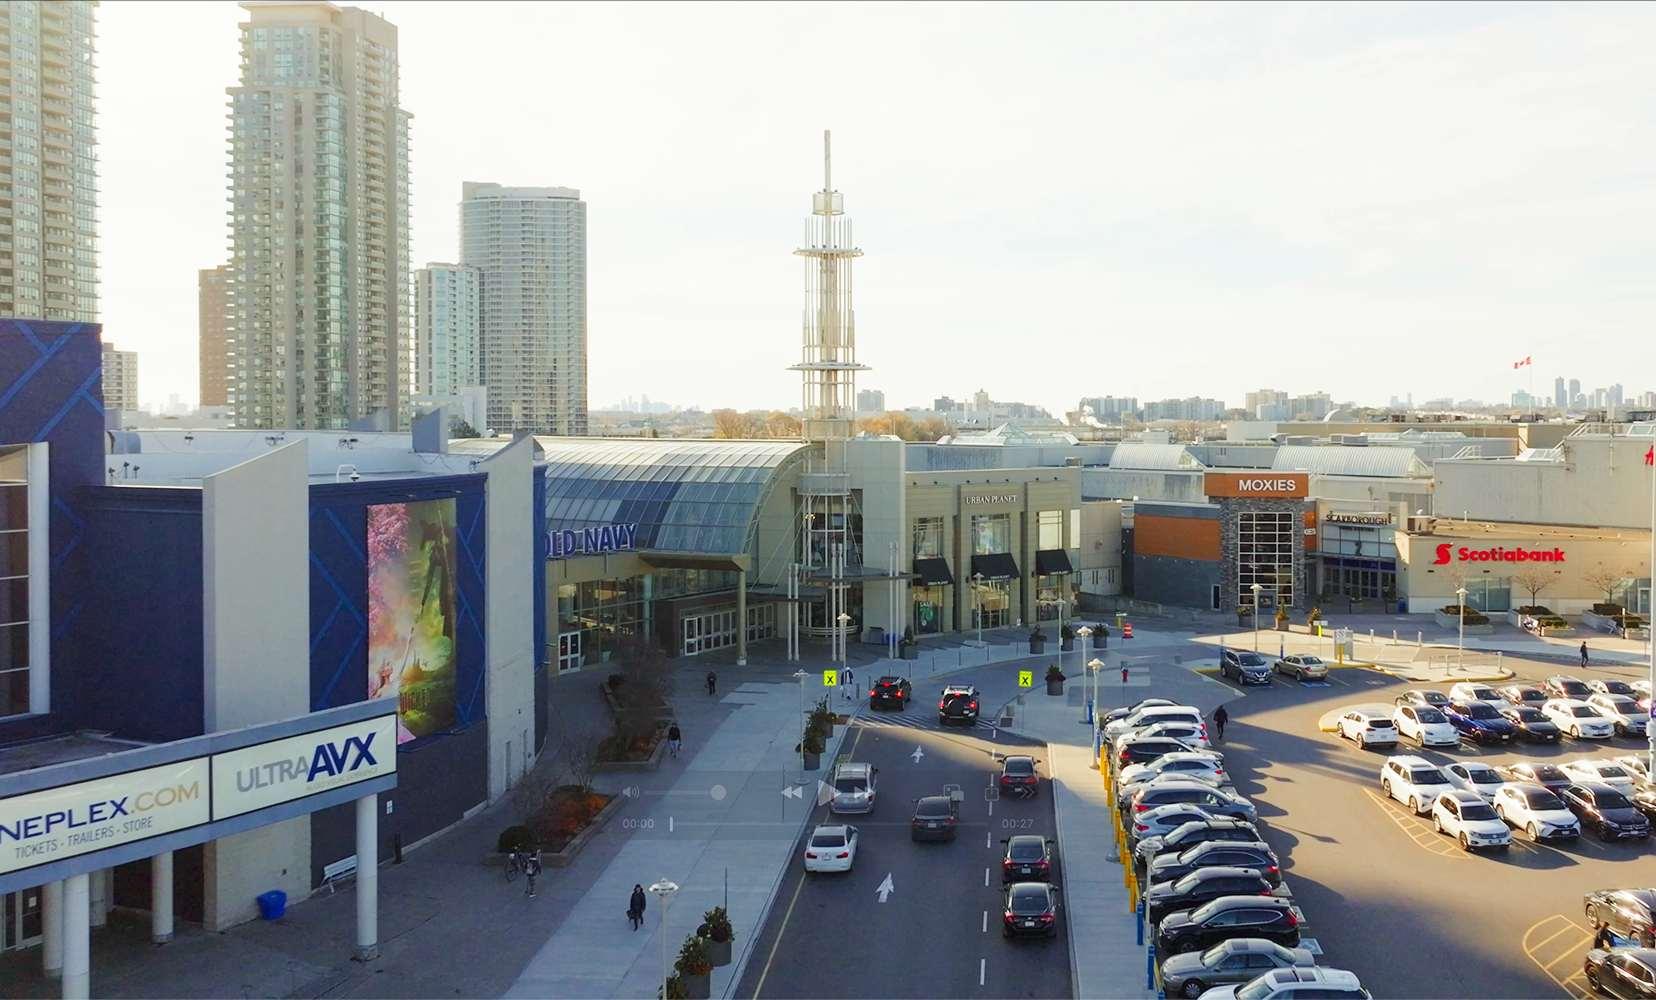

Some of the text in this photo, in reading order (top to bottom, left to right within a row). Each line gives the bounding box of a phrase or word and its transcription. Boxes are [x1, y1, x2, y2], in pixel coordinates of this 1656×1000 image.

[1238, 479, 1296, 492] MOXIES
[966, 495, 1017, 504] URBAN PLANET
[583, 523, 638, 554] NAVY
[1458, 547, 1565, 563] Scotiabank
[15, 840, 58, 860] TICKETS
[67, 826, 115, 847] TRAILERS
[123, 816, 153, 834] STORE
